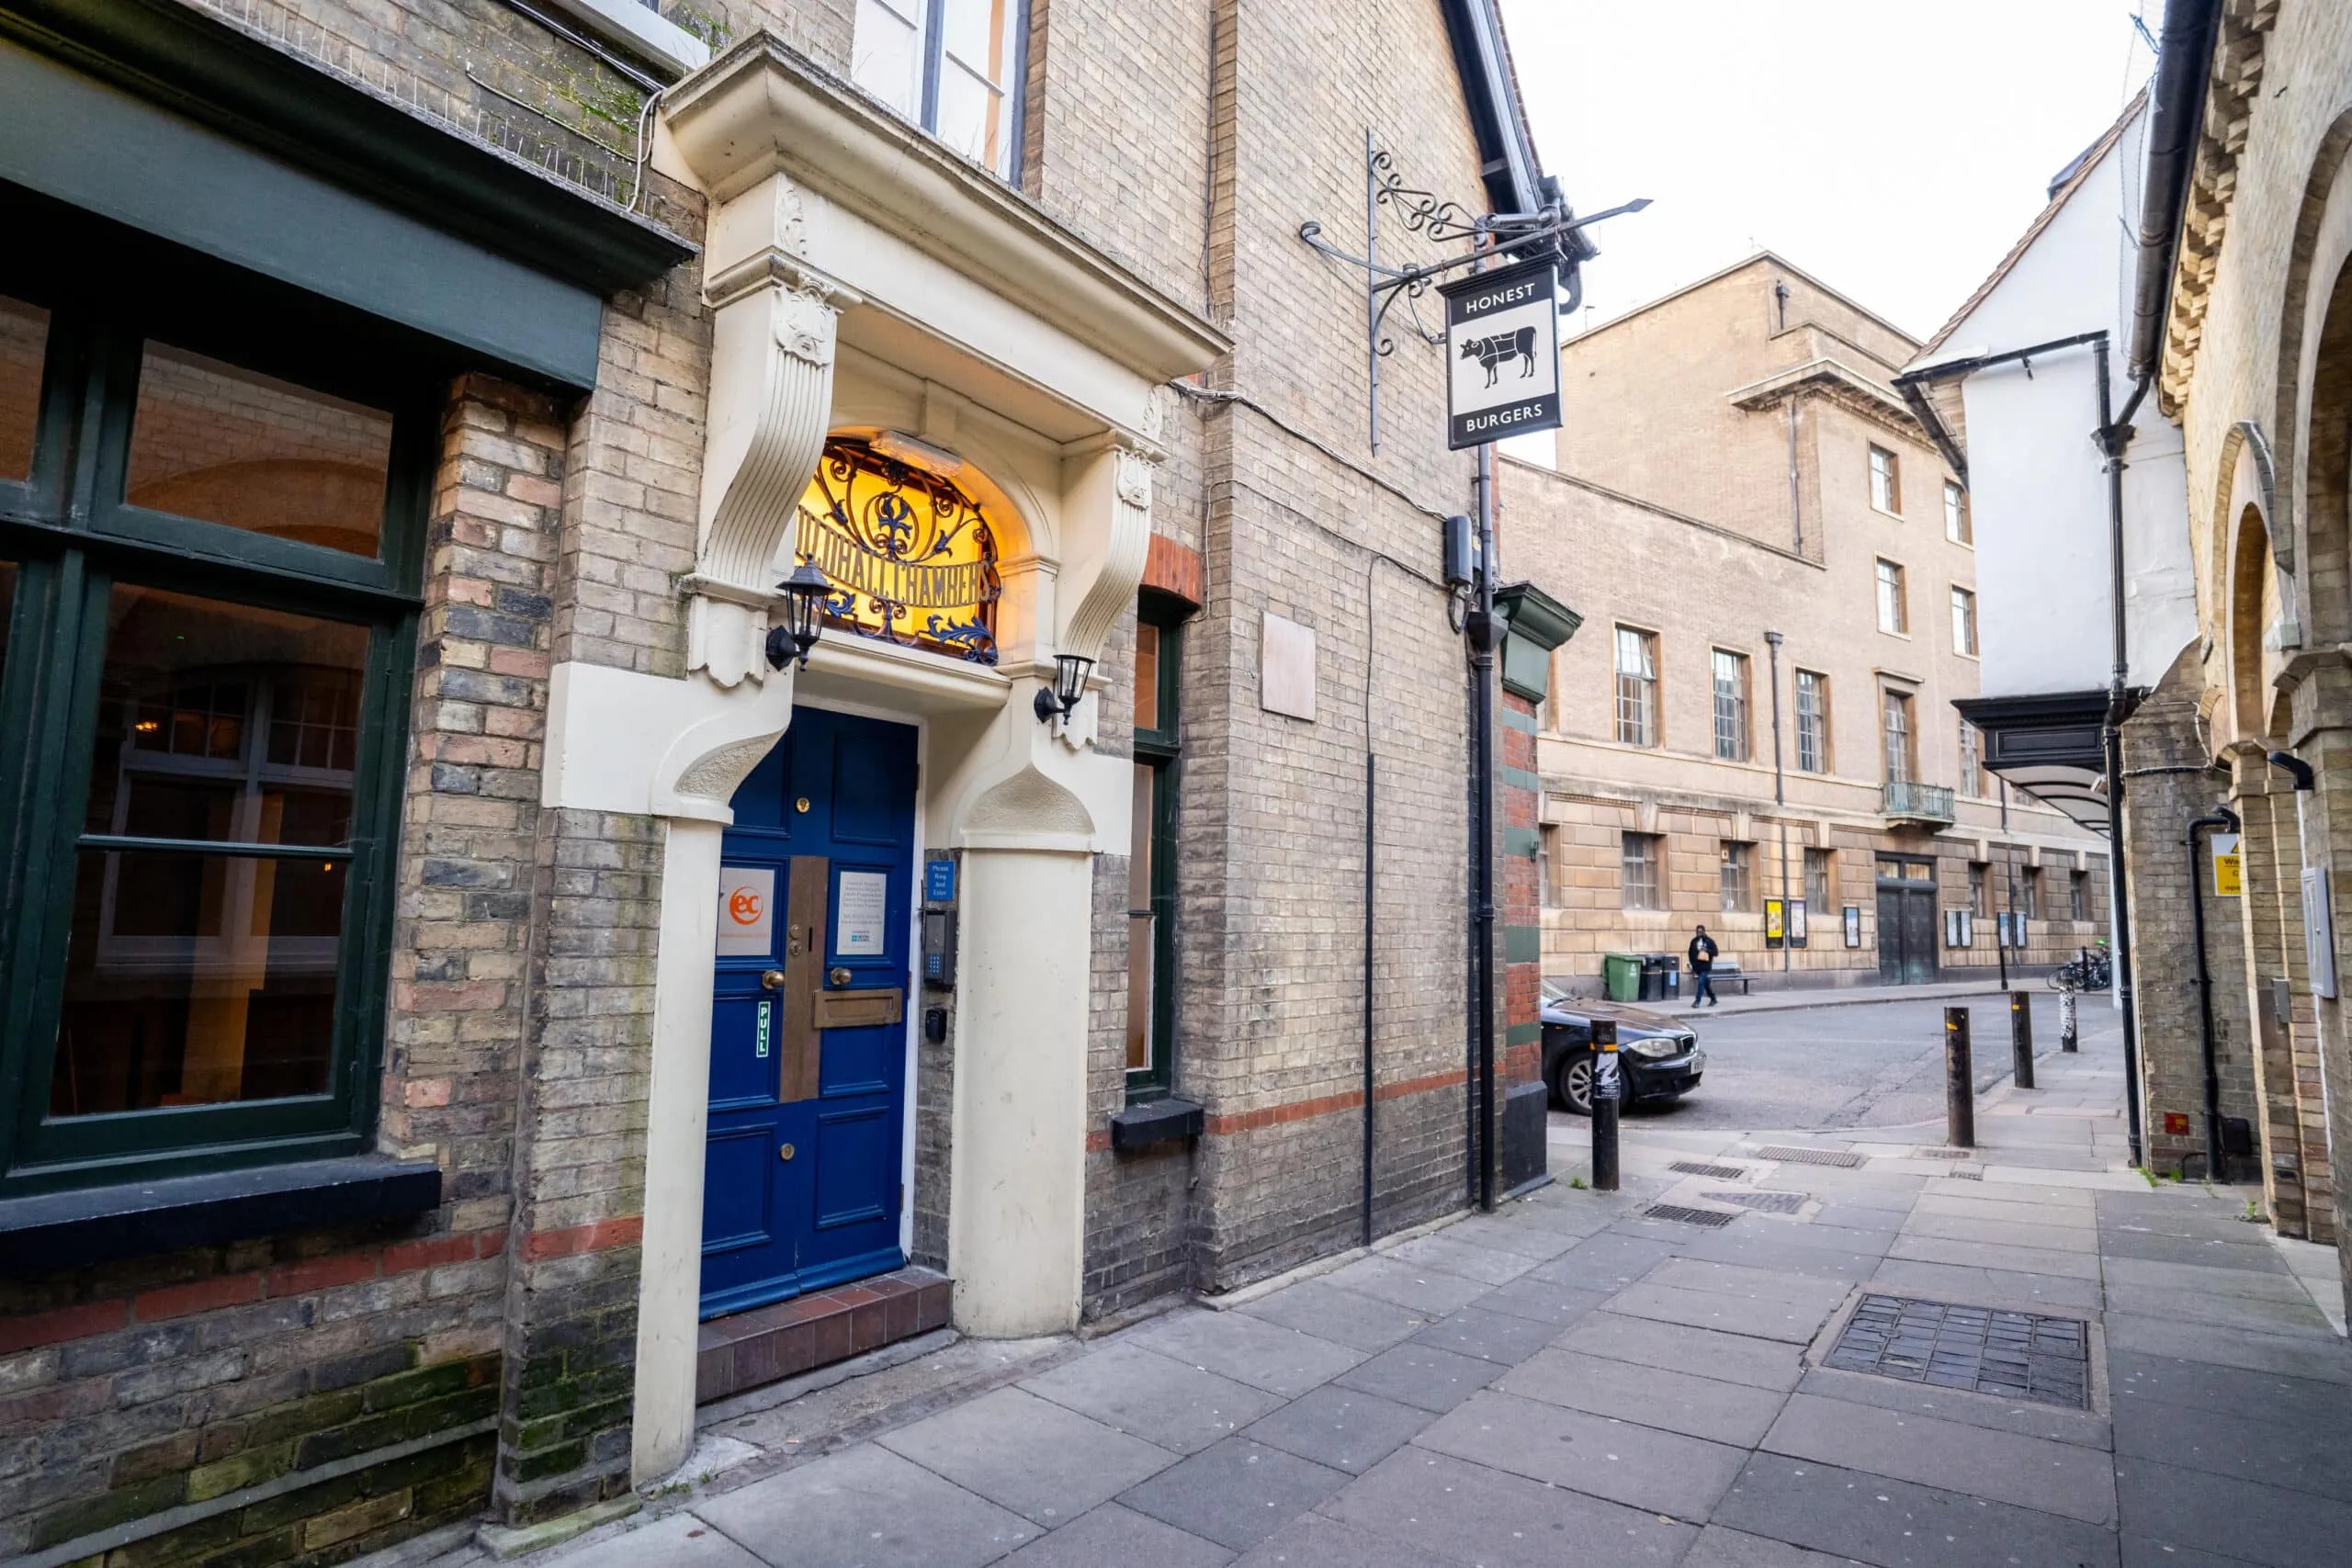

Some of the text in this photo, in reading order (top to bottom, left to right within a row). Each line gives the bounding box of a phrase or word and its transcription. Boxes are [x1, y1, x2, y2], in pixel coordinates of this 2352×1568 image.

[1466, 283, 1535, 314] HONEST
[1466, 403, 1543, 432] BURGERS
[894, 558, 990, 607] CHAMBERS
[759, 1007, 768, 1053] PULL
